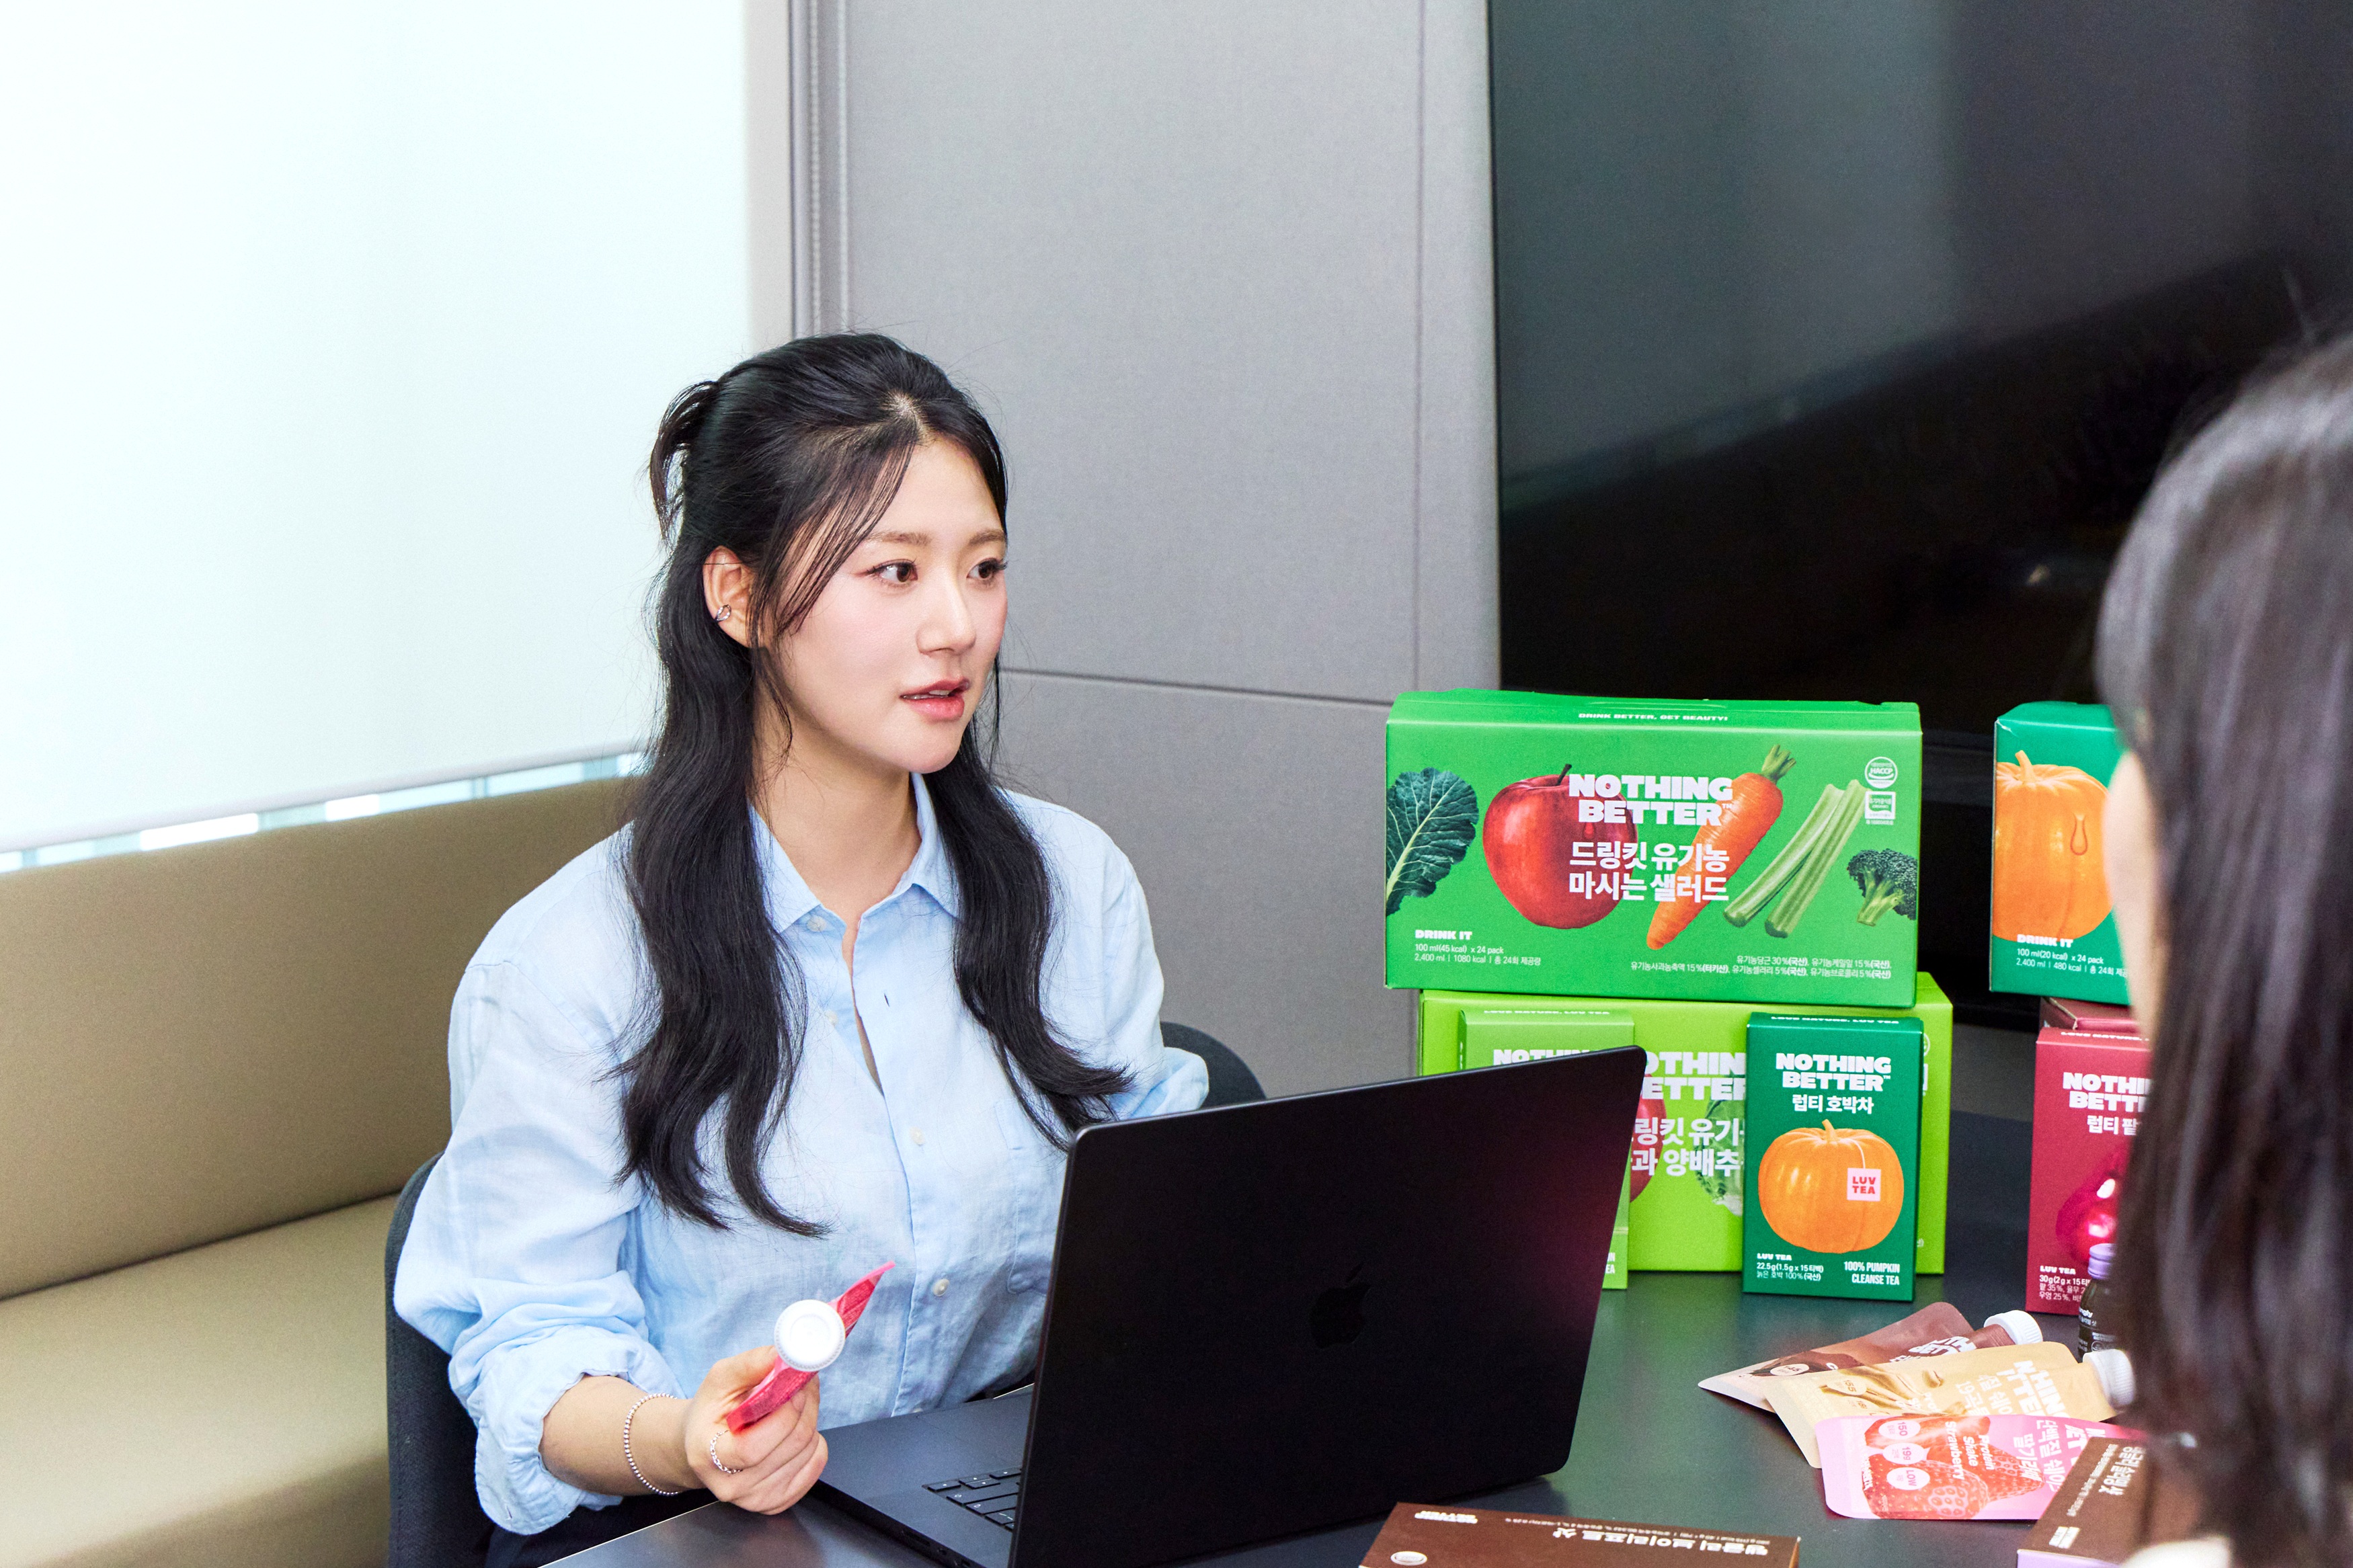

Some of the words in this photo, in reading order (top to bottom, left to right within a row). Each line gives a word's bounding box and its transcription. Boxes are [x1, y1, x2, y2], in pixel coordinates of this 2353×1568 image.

[1568, 774, 1733, 801] NOTHING
[1570, 841, 1647, 870] 드링킷
[1650, 843, 1730, 872] 유기농
[1569, 871, 1647, 901] 마시는
[1650, 874, 1729, 903] 샐러드
[1414, 930, 1456, 940] DRINK
[1459, 931, 1472, 940] IT
[2017, 934, 2058, 946] DRINK
[2060, 938, 2073, 948] IT
[1415, 944, 1428, 952] 100
[1487, 946, 1504, 954] pack
[2018, 948, 2030, 956] 100
[2087, 956, 2104, 964] pack
[1454, 954, 1471, 962] 1080
[1472, 955, 1486, 963] kcal
[1737, 955, 1771, 965] 유기농당근
[1776, 1053, 1892, 1074] NOTHING
[2063, 1072, 2152, 1095] NOTHI
[1792, 1094, 1823, 1113] 럽티
[1826, 1096, 1874, 1114] 호박차
[1632, 1117, 1684, 1145] 링킷
[1688, 1118, 1745, 1146] 유기
[2087, 1115, 2119, 1135] 럽티
[1631, 1148, 1659, 1176] 과
[1663, 1148, 1743, 1177] 양배추
[1852, 1176, 1876, 1185] LUV
[1852, 1186, 1876, 1194] TEA
[1605, 1264, 1616, 1274] EA
[1844, 1261, 1865, 1272] 100%
[1866, 1262, 1900, 1273] PUMPKIN
[1851, 1274, 1884, 1284] CLEANSE
[1886, 1275, 1900, 1285] TEA
[1898, 1421, 1908, 1437] 150
[2036, 1419, 2063, 1458] 단백질
[1902, 1446, 1912, 1460] 19g
[1945, 1421, 1965, 1480] Strawberry
[1963, 1436, 1979, 1467] Shake
[1979, 1434, 1996, 1471] Protein
[1906, 1469, 1917, 1487] LOW
